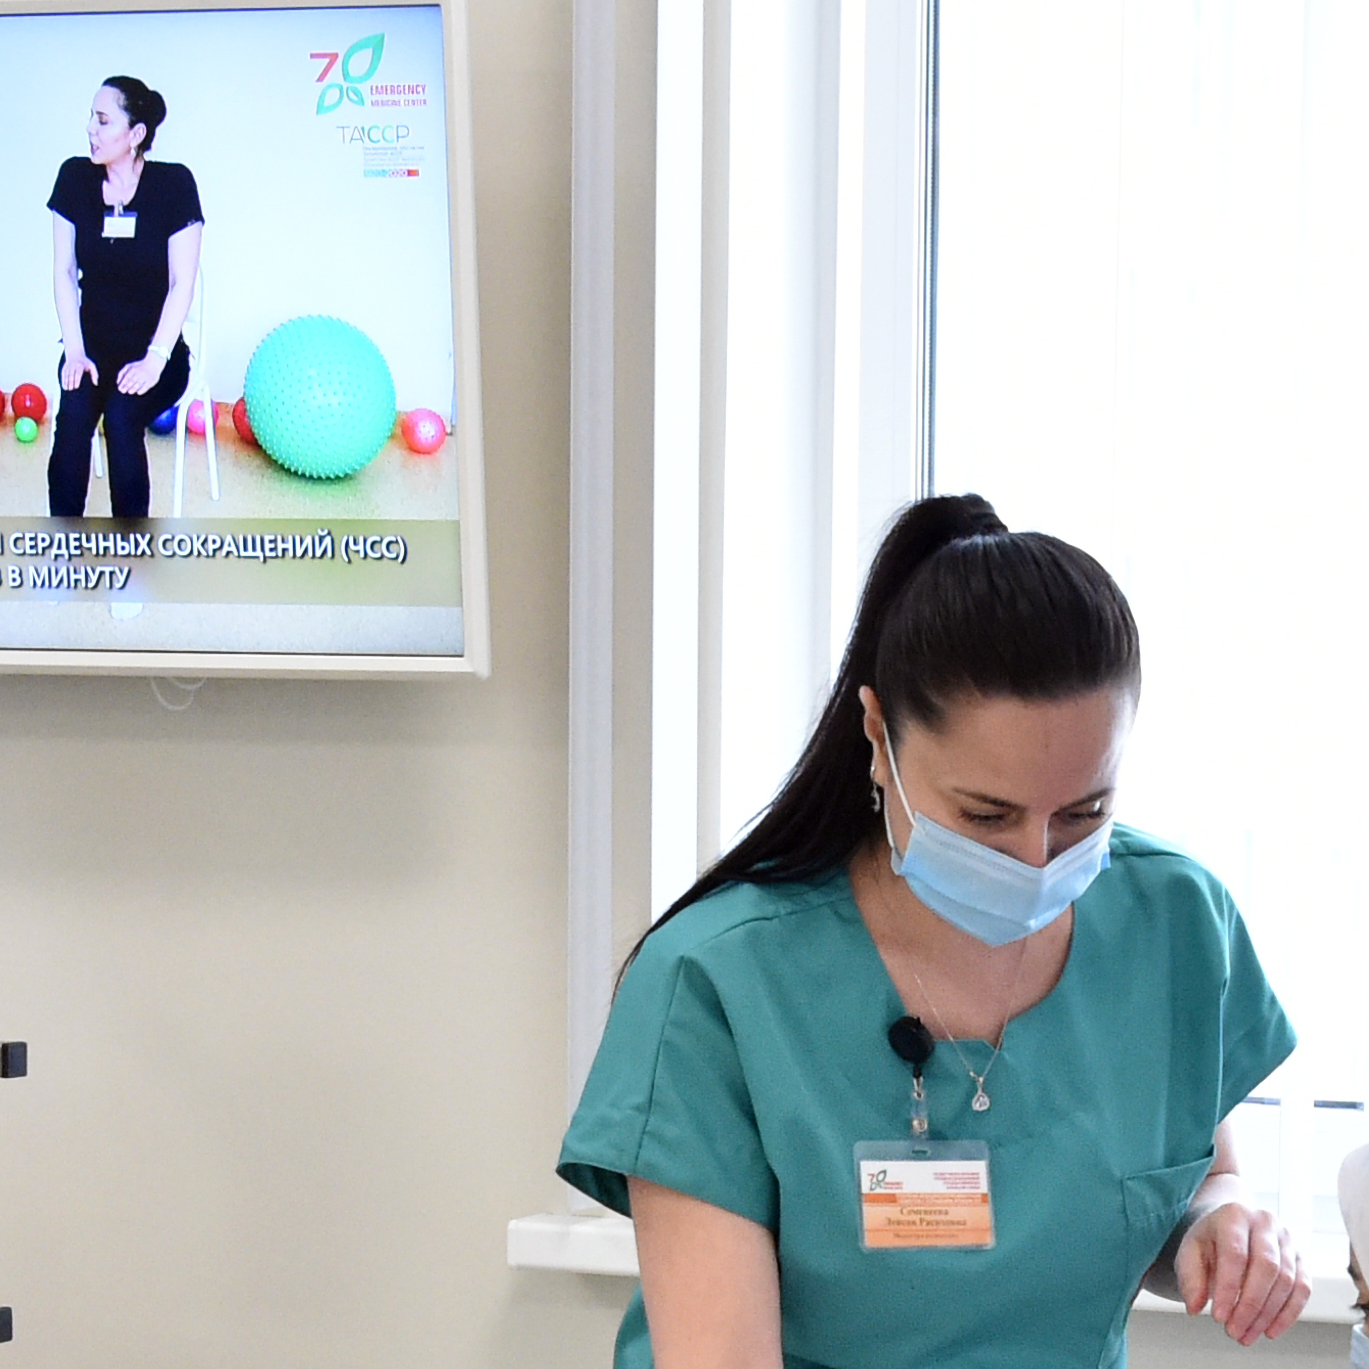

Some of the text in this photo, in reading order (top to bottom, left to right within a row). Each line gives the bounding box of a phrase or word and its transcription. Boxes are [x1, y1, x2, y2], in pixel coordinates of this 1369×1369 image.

[370, 84, 427, 96] EMERGENCY
[9, 532, 152, 560] СЕРДЕЧНЫХ
[157, 528, 334, 562] СОКРАЩЕНИЙ
[340, 534, 408, 563] (ЧСС)
[8, 565, 22, 587] В
[29, 565, 129, 589] МИНУТУ
